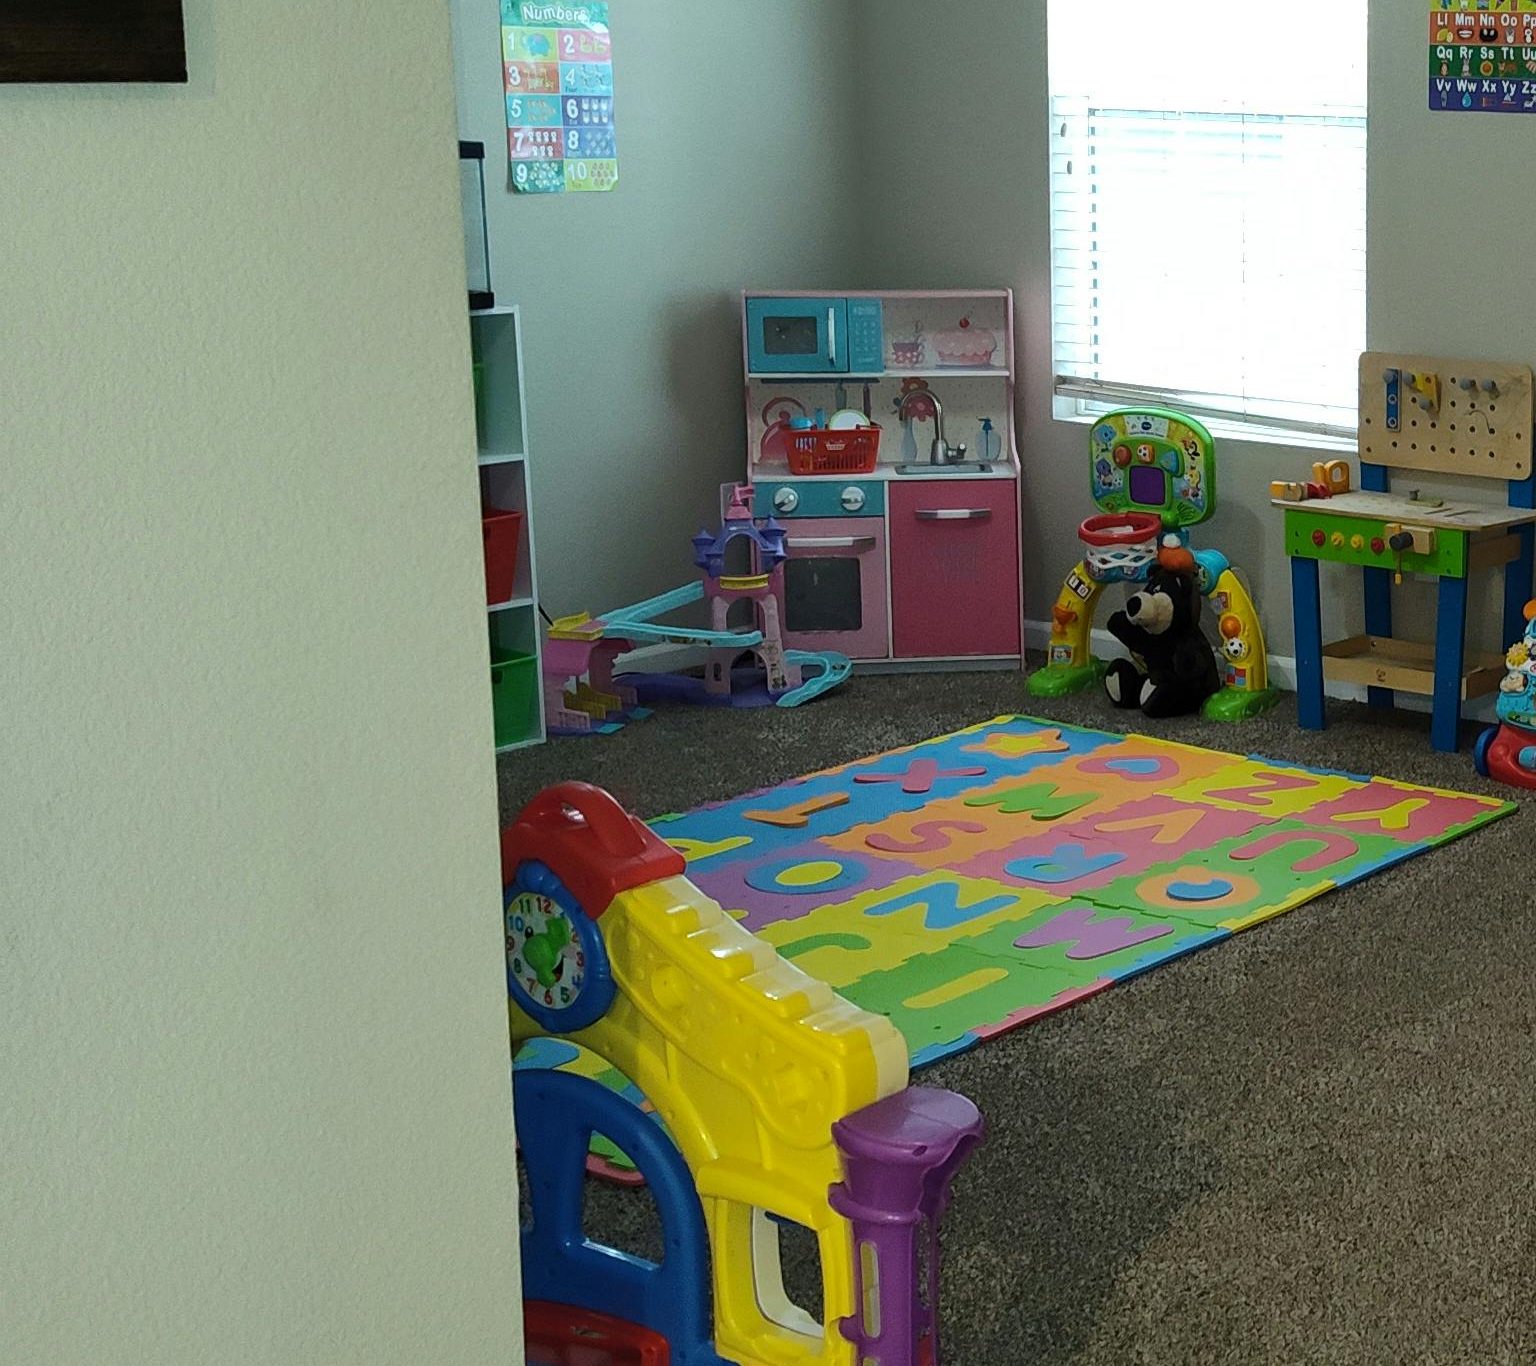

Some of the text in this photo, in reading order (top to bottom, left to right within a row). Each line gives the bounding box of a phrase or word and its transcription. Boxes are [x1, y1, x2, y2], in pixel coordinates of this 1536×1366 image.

[522, 4, 589, 21] Numbers
[1437, 13, 1448, 26] Ll
[1455, 13, 1475, 26] Mm
[1480, 13, 1495, 26] Nn
[1500, 14, 1518, 27] Oo
[508, 32, 515, 51] 1
[564, 34, 575, 54] 2
[1436, 46, 1453, 62] Qq
[1460, 46, 1473, 59] Rr
[1480, 46, 1495, 59] Ss
[1501, 47, 1515, 60] Tt
[508, 65, 521, 86] 3
[565, 68, 575, 86] 4
[1436, 78, 1452, 92] Vv
[1456, 78, 1477, 93] Ww
[1481, 79, 1497, 93] Xx
[1501, 80, 1517, 96] Yy
[511, 98, 522, 118] 5
[566, 98, 579, 119] 6
[513, 131, 524, 152] 7
[568, 130, 579, 149] 8
[516, 163, 528, 183] 9
[568, 161, 587, 181] 10
[853, 759, 987, 793] X
[1202, 772, 1430, 830] Y Z
[865, 820, 988, 853] S
[744, 855, 870, 895] O
[519, 899, 530, 914] 11
[536, 896, 551, 914] 12
[509, 915, 524, 932] 10
[514, 957, 522, 974] 8
[544, 988, 553, 1005] 6
[560, 987, 570, 1003] 5
